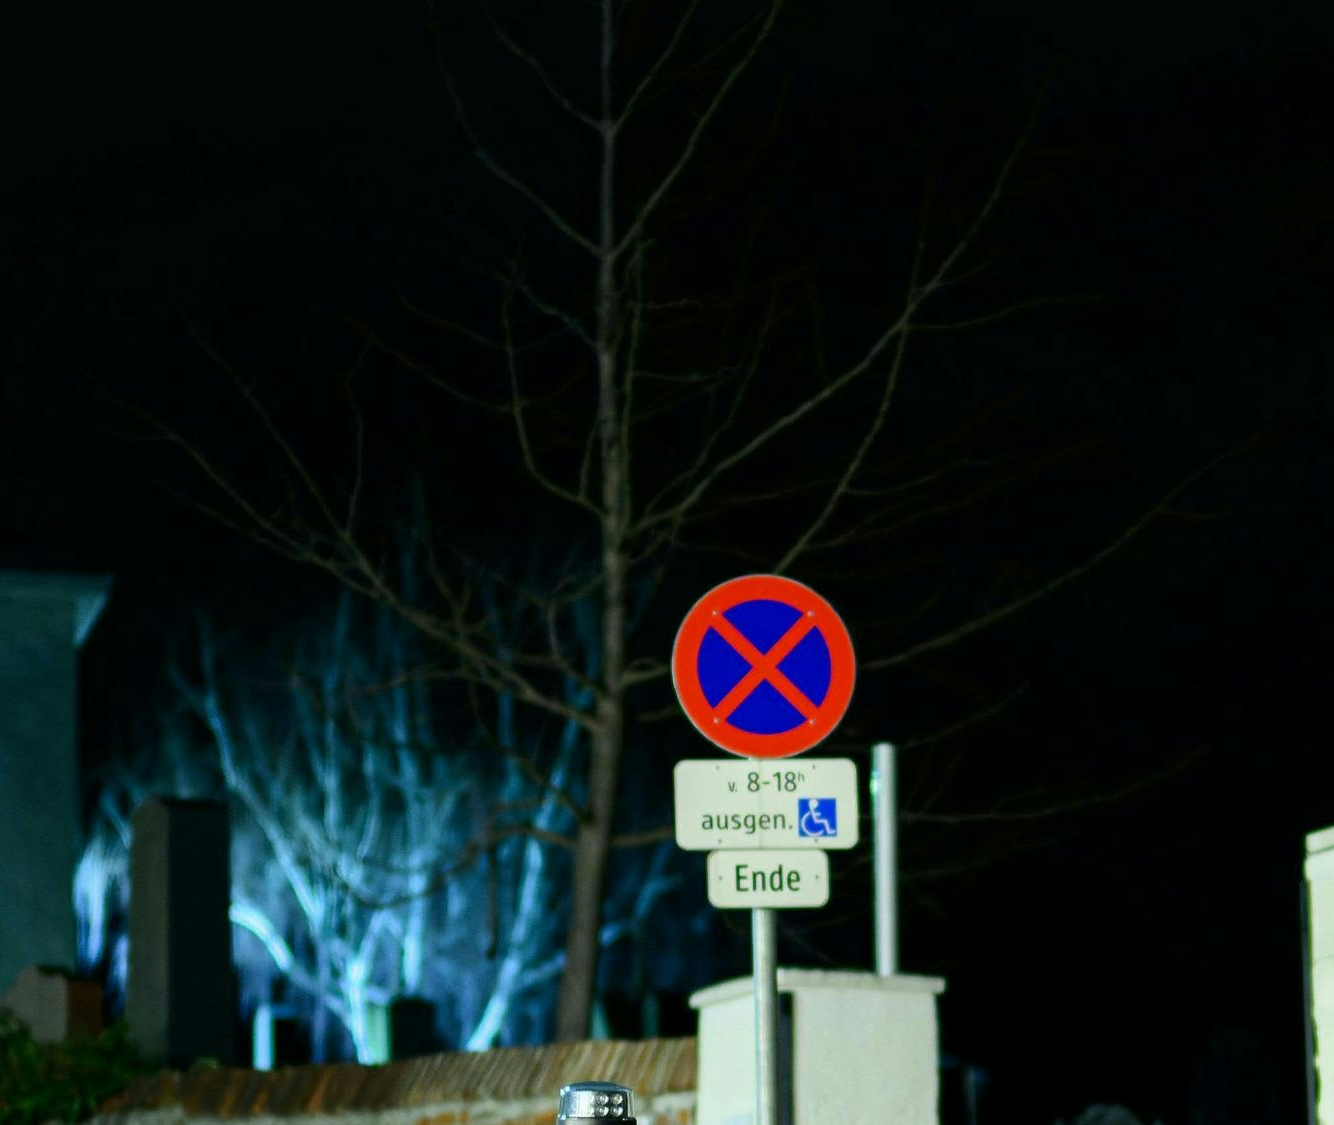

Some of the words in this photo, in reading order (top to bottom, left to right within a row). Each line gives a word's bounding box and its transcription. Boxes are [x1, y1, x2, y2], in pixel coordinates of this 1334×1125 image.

[728, 781, 738, 792] v.
[701, 813, 793, 835] ausgen.
[735, 864, 801, 892] Ende
